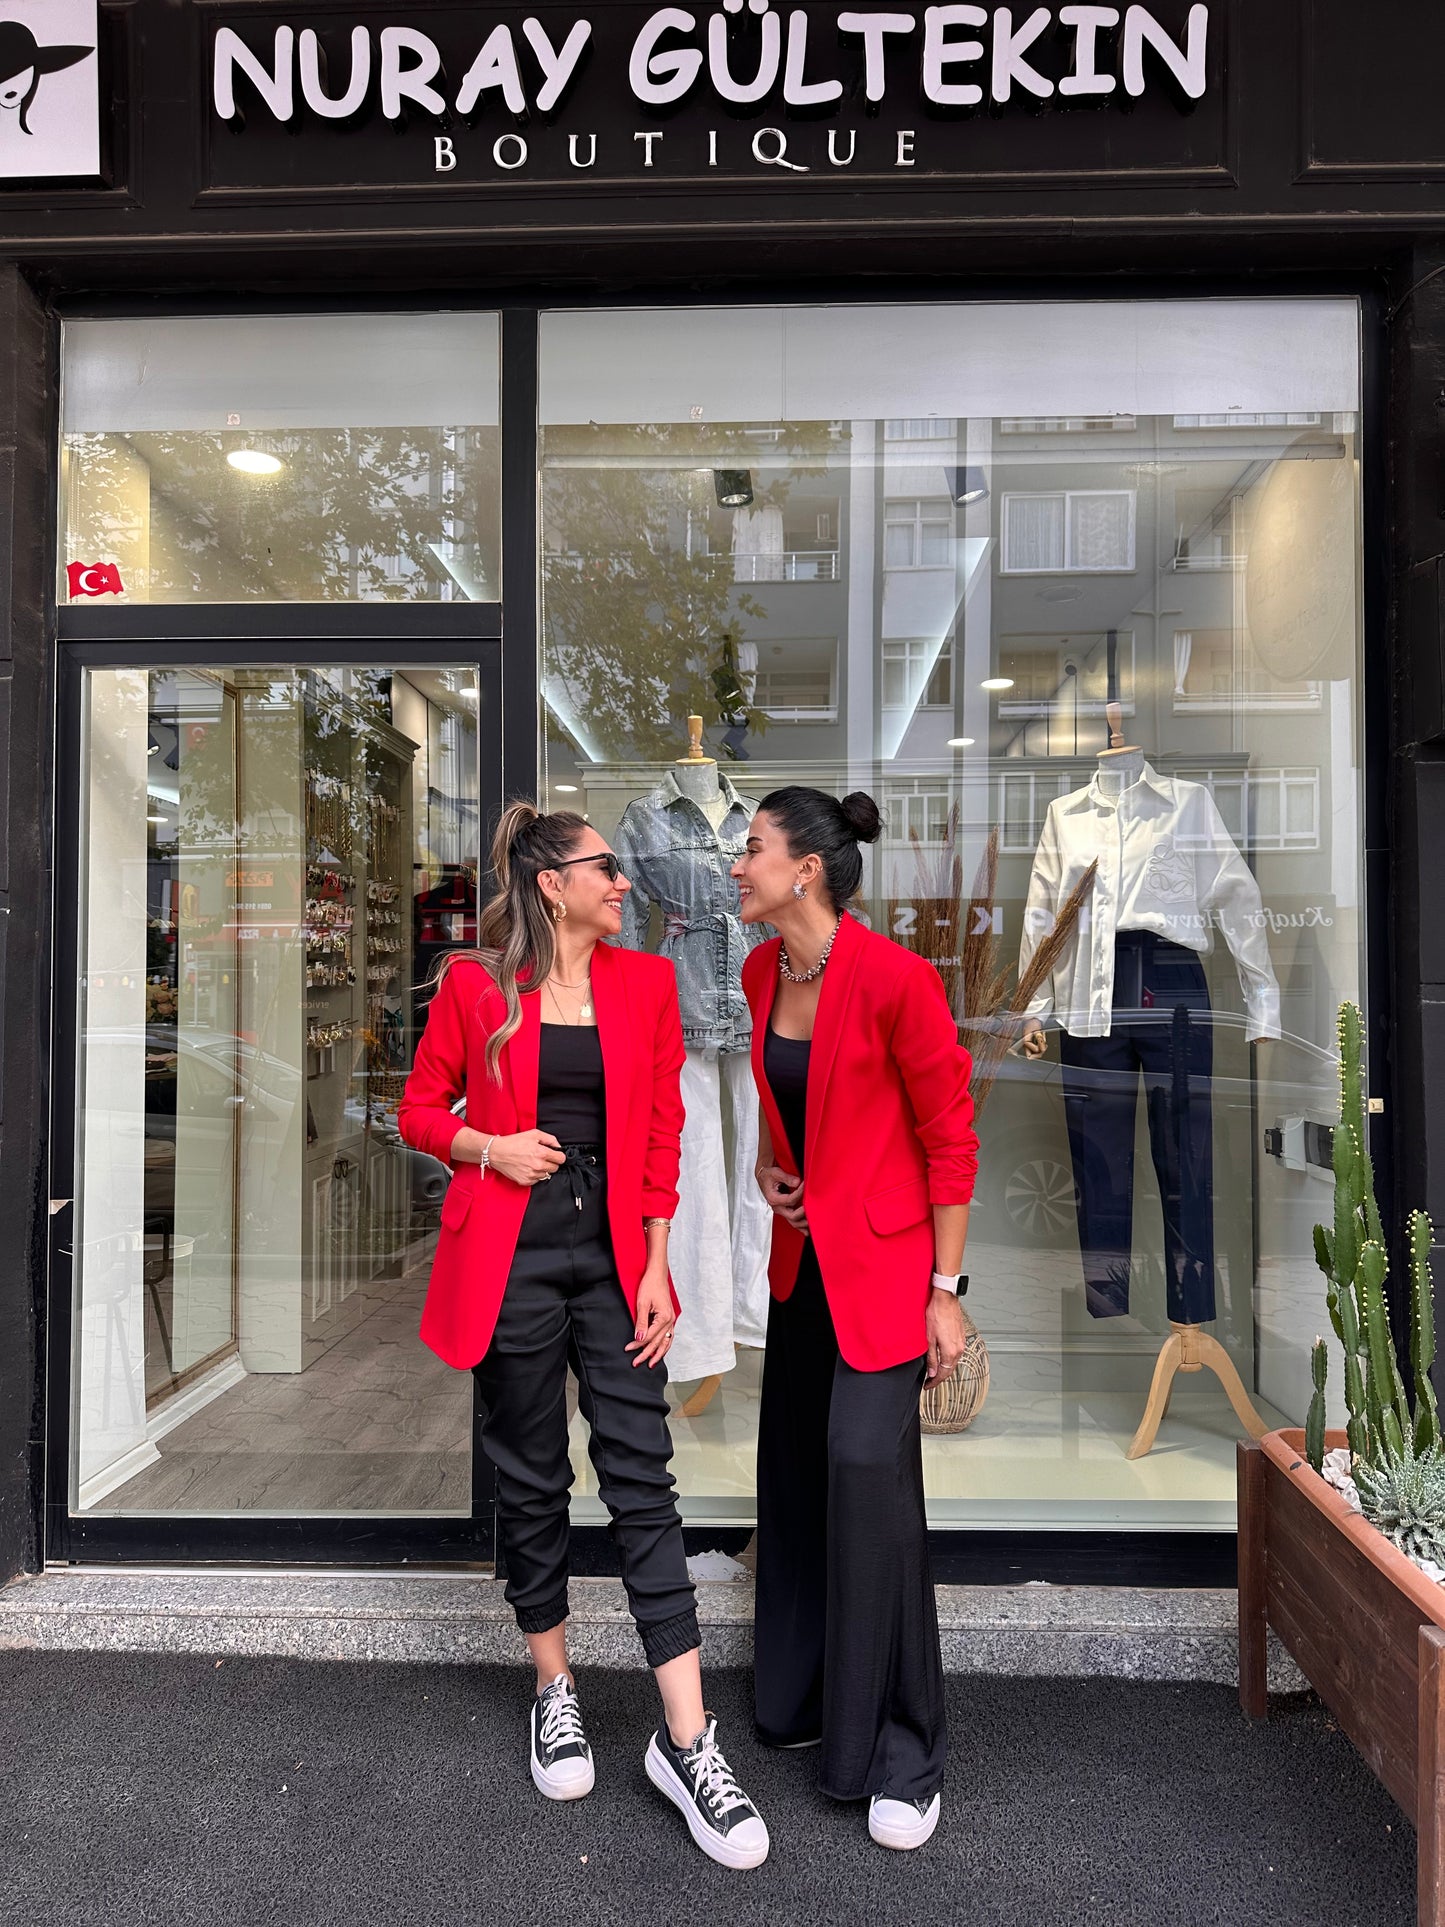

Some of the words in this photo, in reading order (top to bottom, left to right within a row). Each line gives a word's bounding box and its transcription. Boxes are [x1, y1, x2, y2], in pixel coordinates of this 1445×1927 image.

[214, 17, 592, 121] NURAY
[629, 0, 1209, 105] GÜLTEKIN
[434, 127, 917, 172] BOUTIQUE
